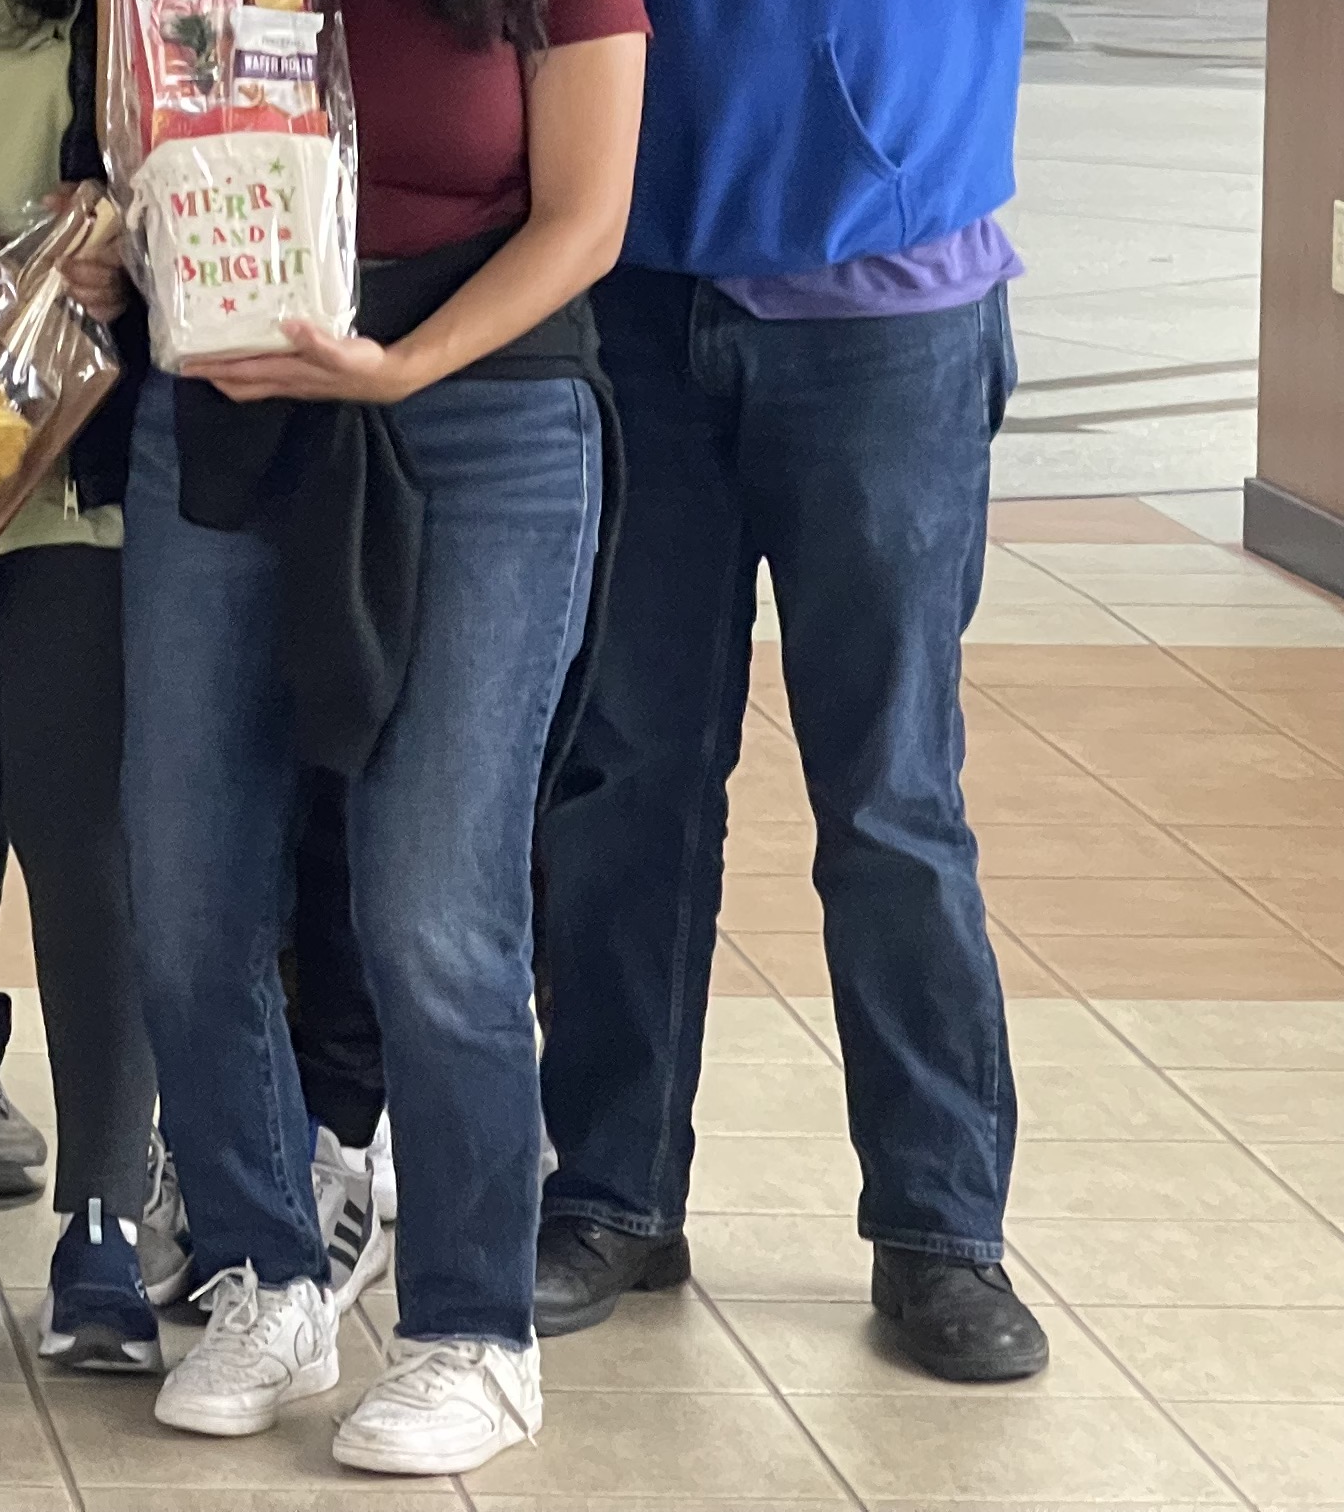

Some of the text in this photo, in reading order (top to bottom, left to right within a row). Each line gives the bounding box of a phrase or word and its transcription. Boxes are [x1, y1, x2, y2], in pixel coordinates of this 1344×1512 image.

[243, 54, 278, 73] WAFER
[170, 183, 297, 220] MERRY
[212, 225, 266, 247] AND
[174, 247, 311, 287] BRIGHT
